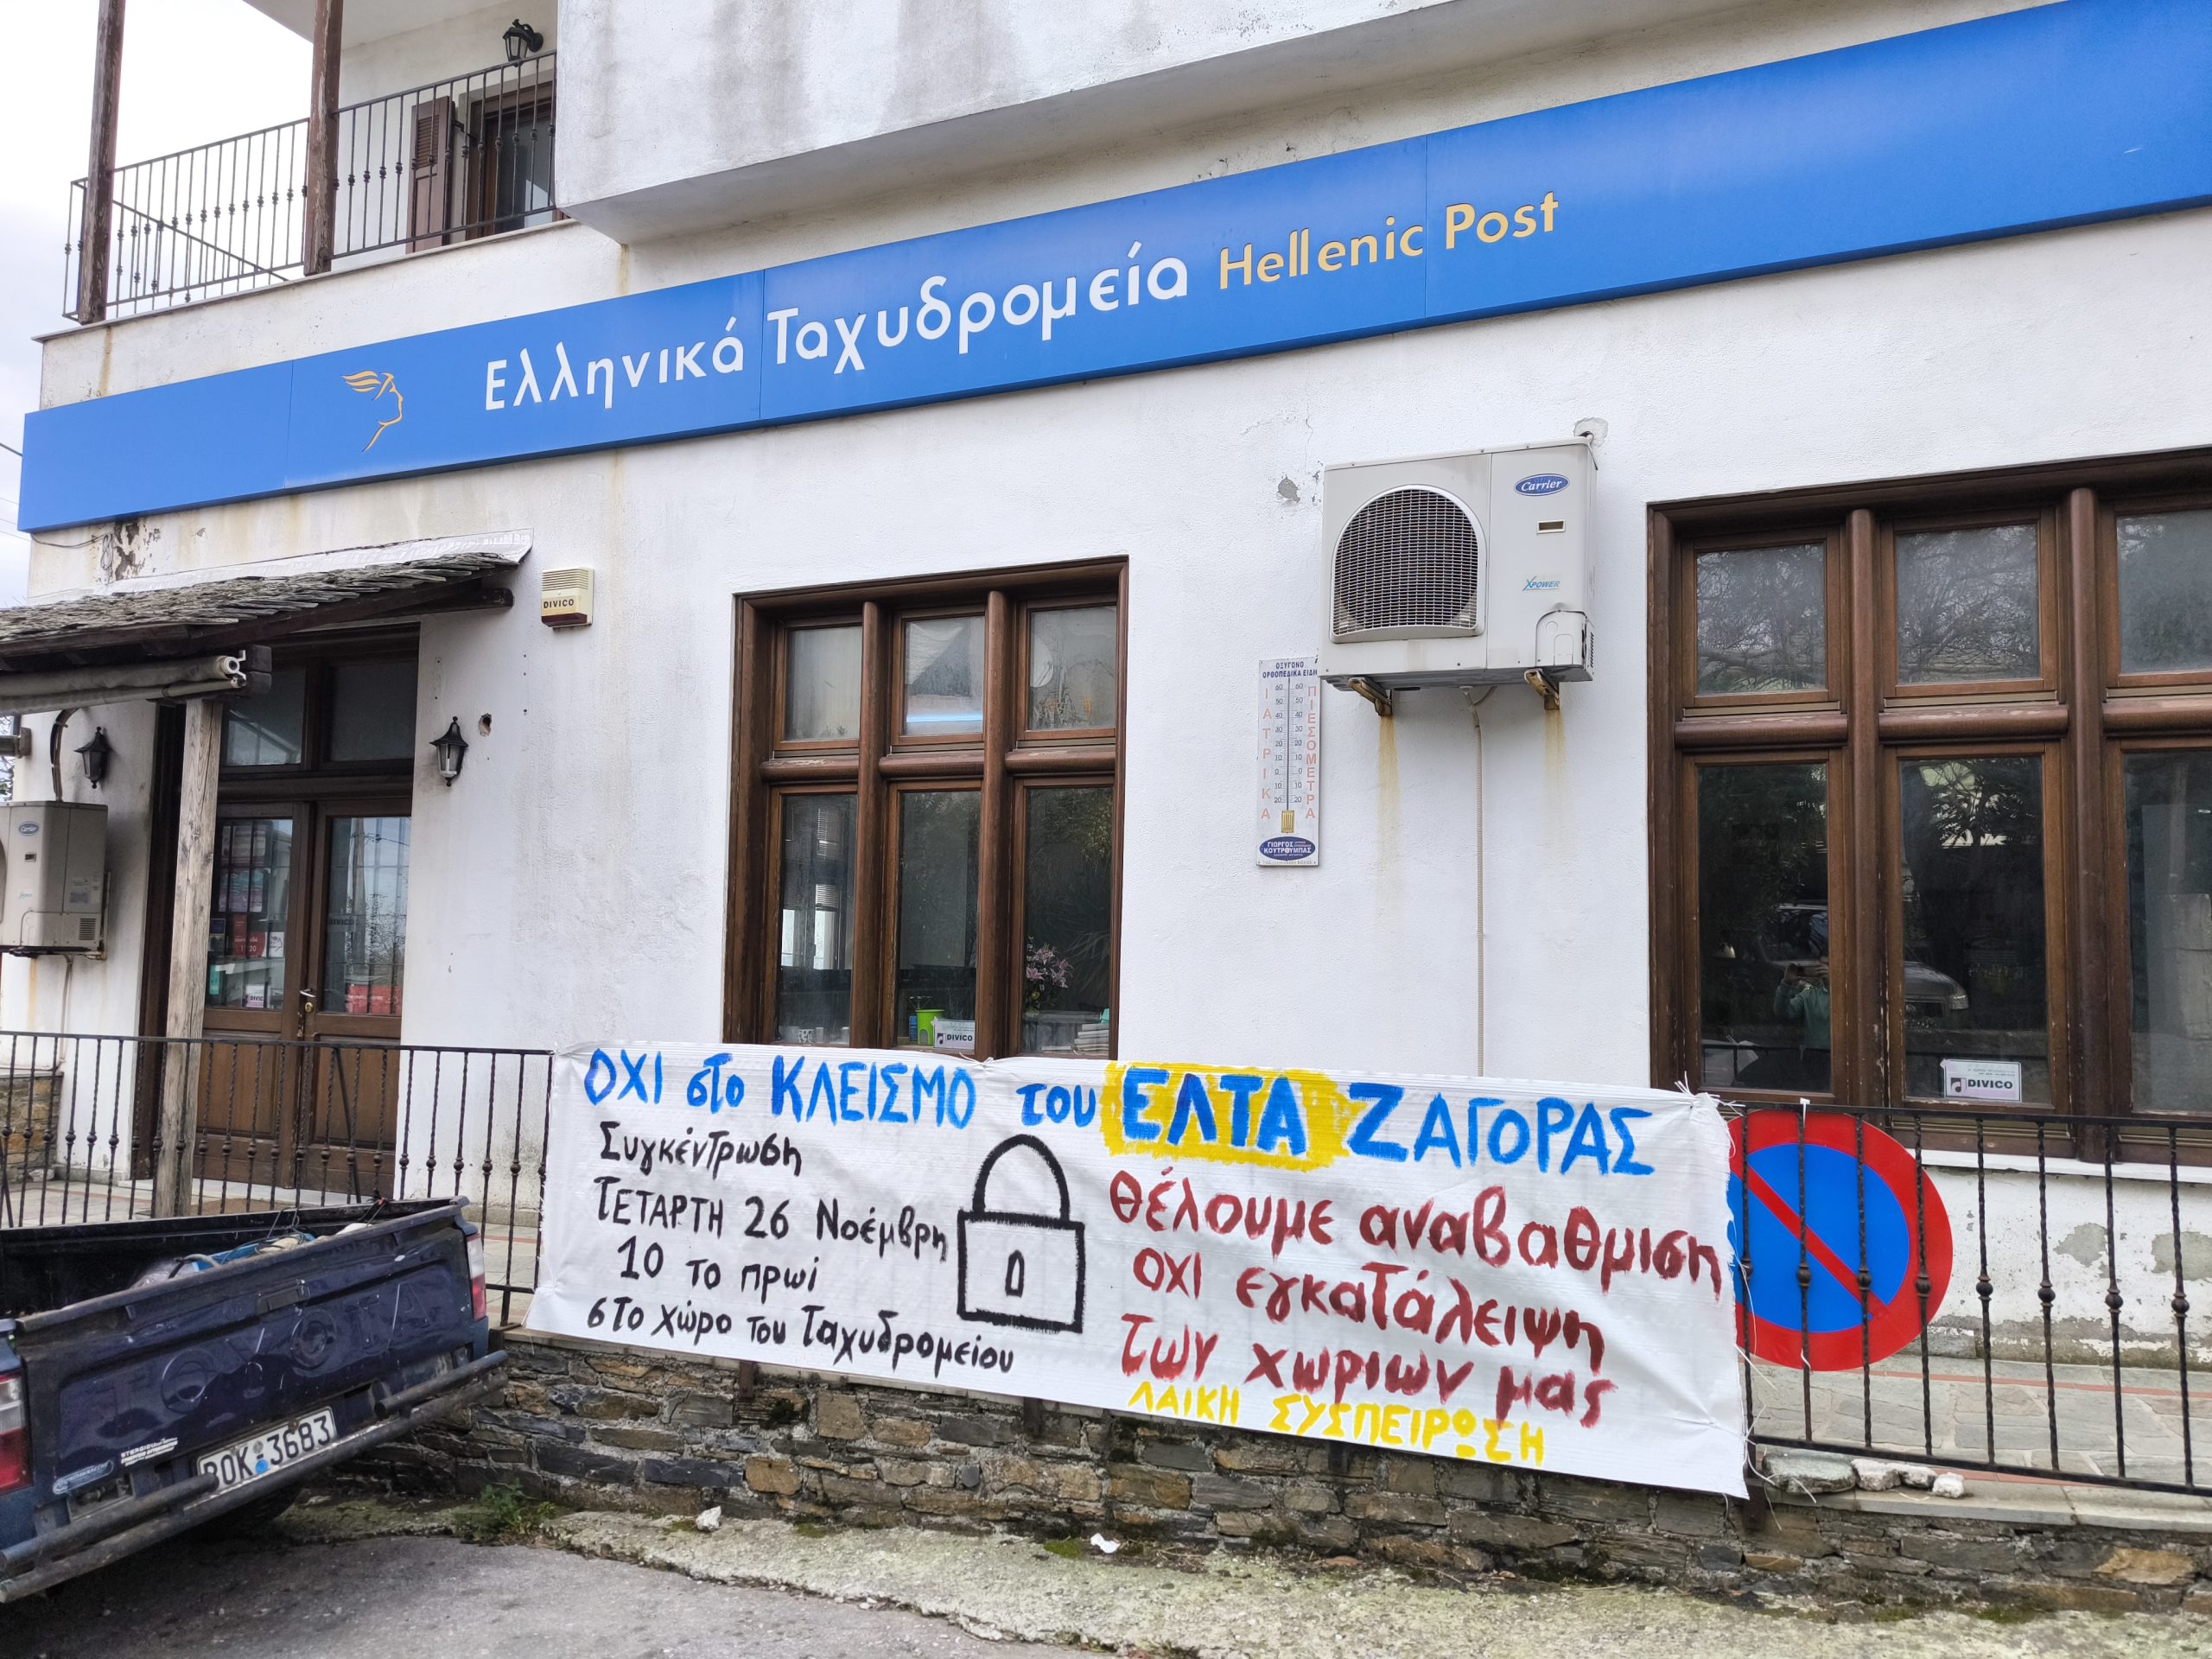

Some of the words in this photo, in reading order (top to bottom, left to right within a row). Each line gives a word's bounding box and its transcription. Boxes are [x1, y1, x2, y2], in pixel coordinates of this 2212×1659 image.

[1219, 216, 1425, 290] Hellenic
[1445, 192, 1559, 250] Post
[484, 316, 744, 411] Ελληνικά
[766, 240, 1189, 375] Ταχυδρομεία
[1521, 480, 1563, 492] Carrier
[543, 599, 575, 608] DIVICO
[1262, 670, 1301, 678] ΟΡΘΟΠΕΔΙΚΑ
[1275, 661, 1304, 670] ΟΞΥΓΟΝΟ
[1261, 688, 1272, 819] ΙΑΤΡΙΚΑ
[1306, 685, 1317, 818] ΠΙΕΣΟΜΕΤΡΑ
[584, 1050, 663, 1106] ΟΧΙ
[771, 1055, 976, 1130] ΚΛΕΙΣΜΟ
[1016, 1084, 1096, 1128] του
[1122, 1069, 1306, 1156] ΕΛΤΑ
[1347, 1082, 1656, 1176] ΖΑΓΟΡΑΣ
[1967, 1079, 2013, 1089] DIVICO
[601, 1122, 801, 1179] Συγκέντρωση
[594, 1177, 722, 1236] ΤΕΤΑΡΤΗ
[745, 1197, 788, 1238] 26
[817, 1199, 947, 1261] Νοέμβρη
[618, 1236, 663, 1279] 10
[802, 1306, 1013, 1376] Ταχυδρομείου
[1269, 1394, 1544, 1465] ΣΥΣΠΕΙΡΩΣΗ
[1492, 1365, 1617, 1429] μας
